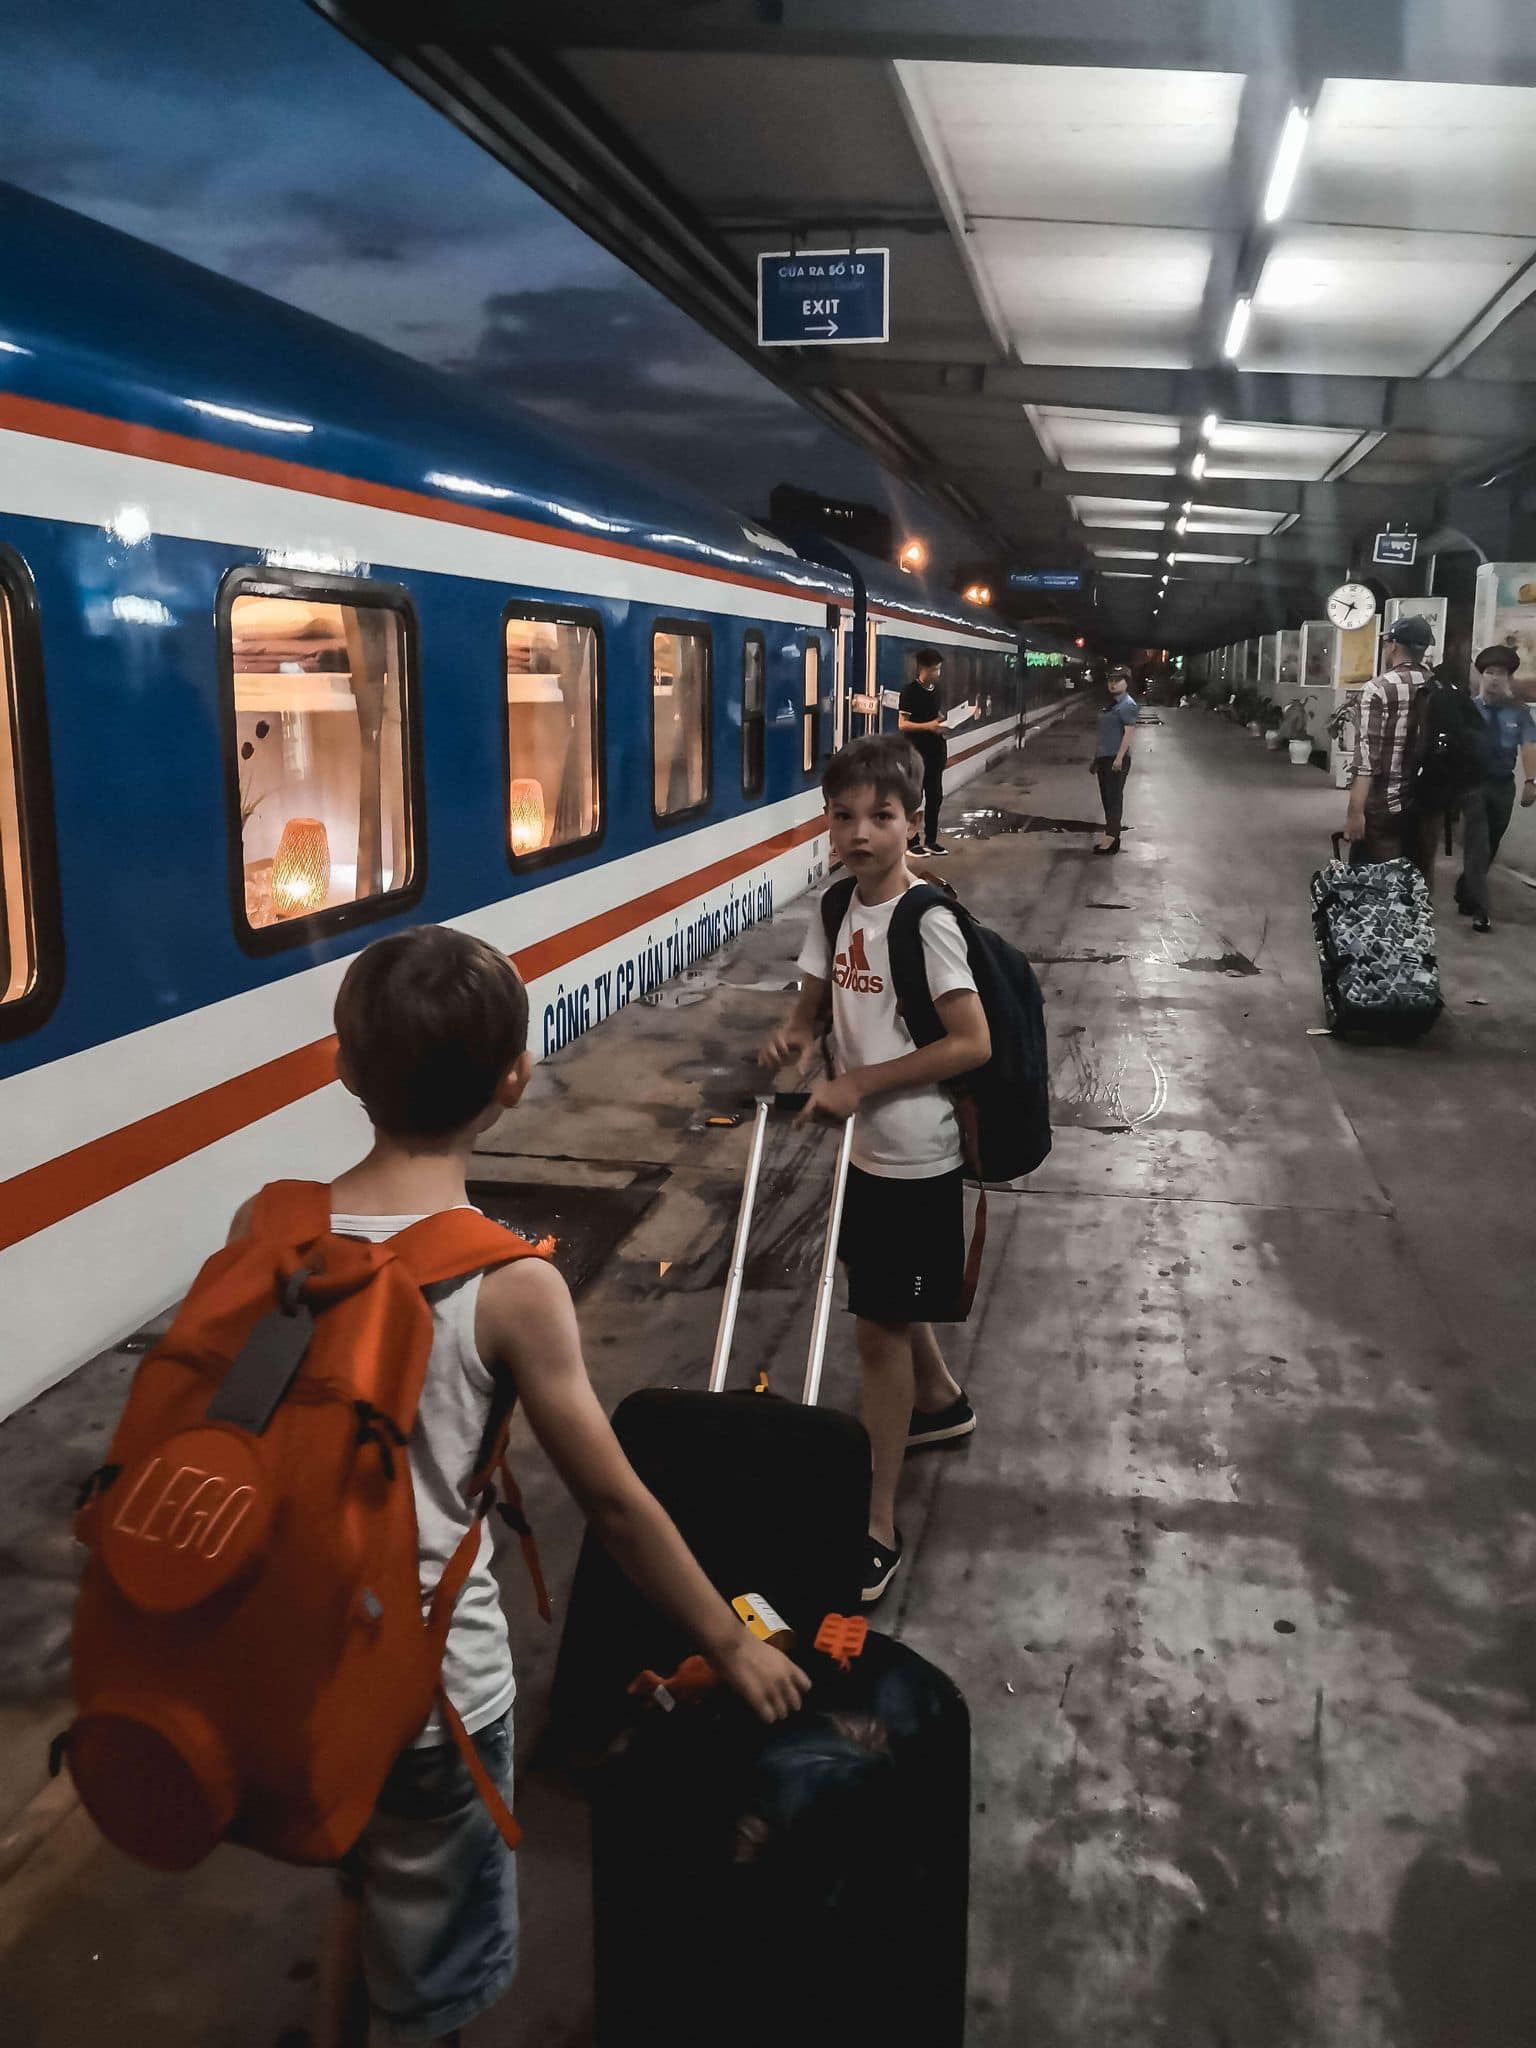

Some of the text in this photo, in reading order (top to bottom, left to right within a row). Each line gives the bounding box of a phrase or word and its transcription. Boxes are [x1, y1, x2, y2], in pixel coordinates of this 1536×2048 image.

[808, 266, 825, 276] RA
[802, 299, 840, 315] EXIT
[543, 984, 590, 1058] CÔNG
[595, 970, 611, 1022] TY
[616, 959, 634, 1010] CP
[113, 1457, 257, 1559] LEGO
